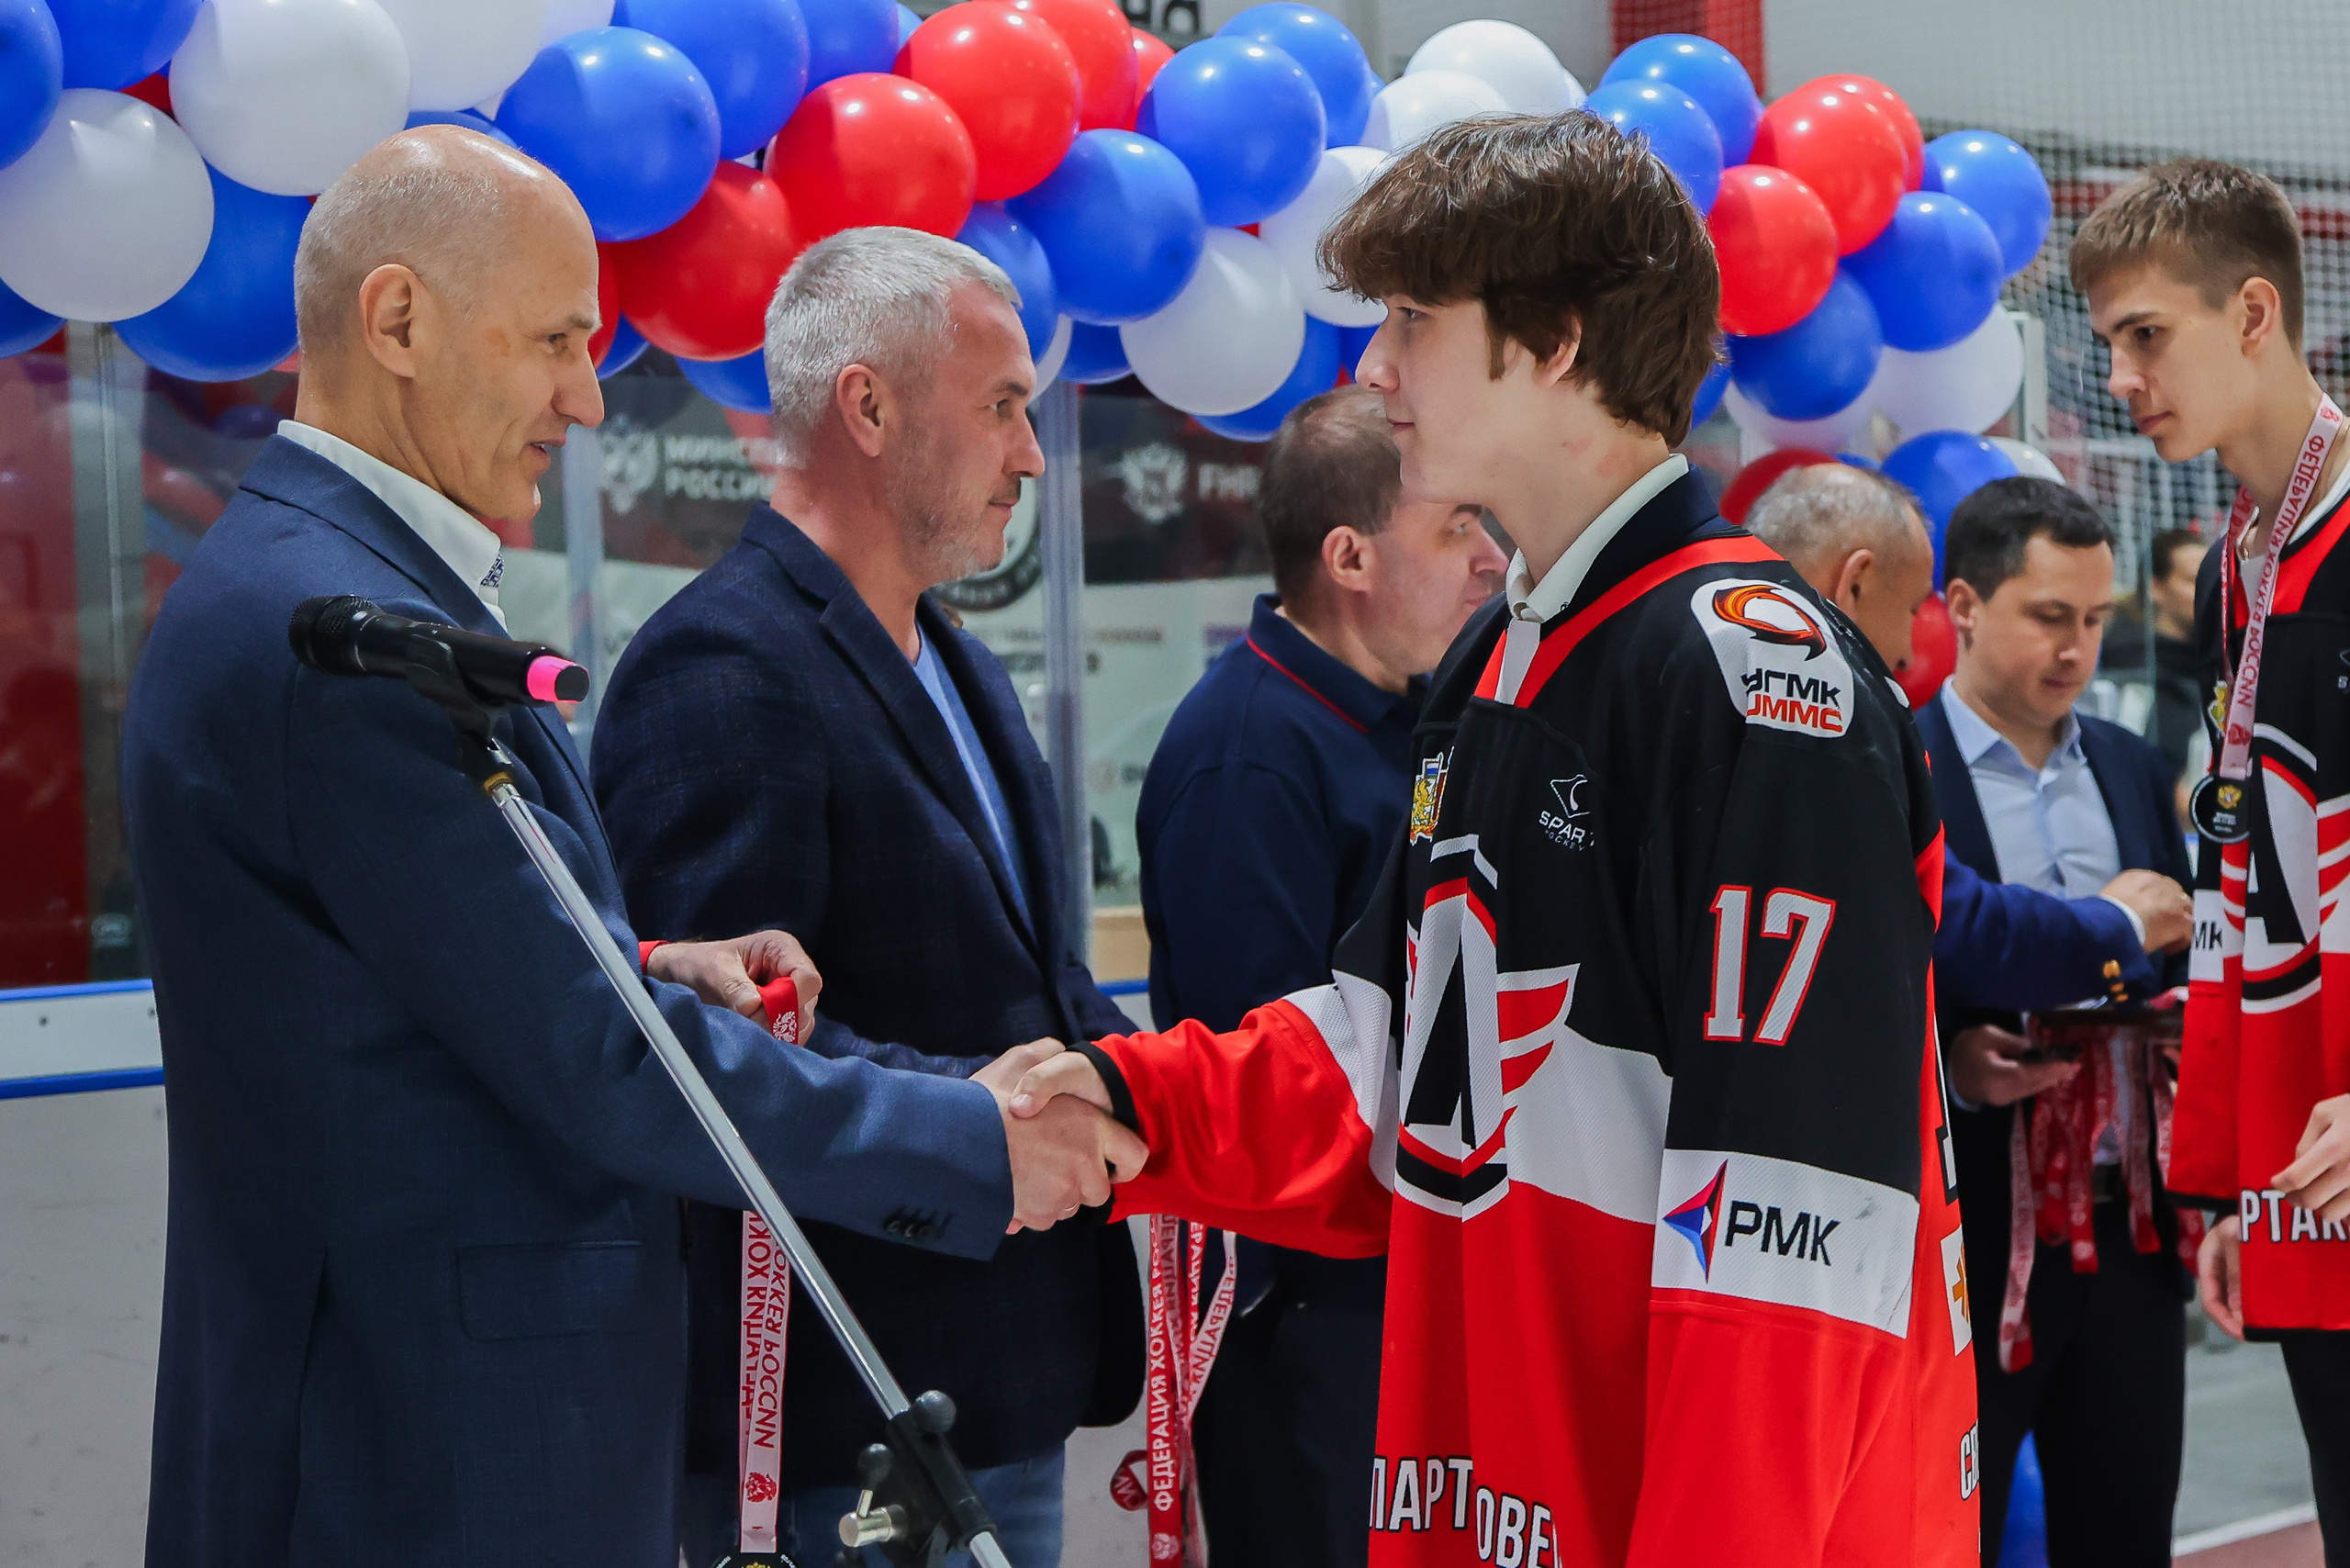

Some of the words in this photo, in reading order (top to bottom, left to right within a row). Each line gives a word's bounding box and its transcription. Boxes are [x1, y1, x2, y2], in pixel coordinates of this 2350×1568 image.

[1539, 810, 1595, 847] SPAR
[1703, 884, 1838, 1046] 17
[1725, 1200, 1841, 1267] РМК
[2240, 1189, 2350, 1242] РТА
[1150, 1376, 1177, 1512] ФЕДЕРАЦИЯ
